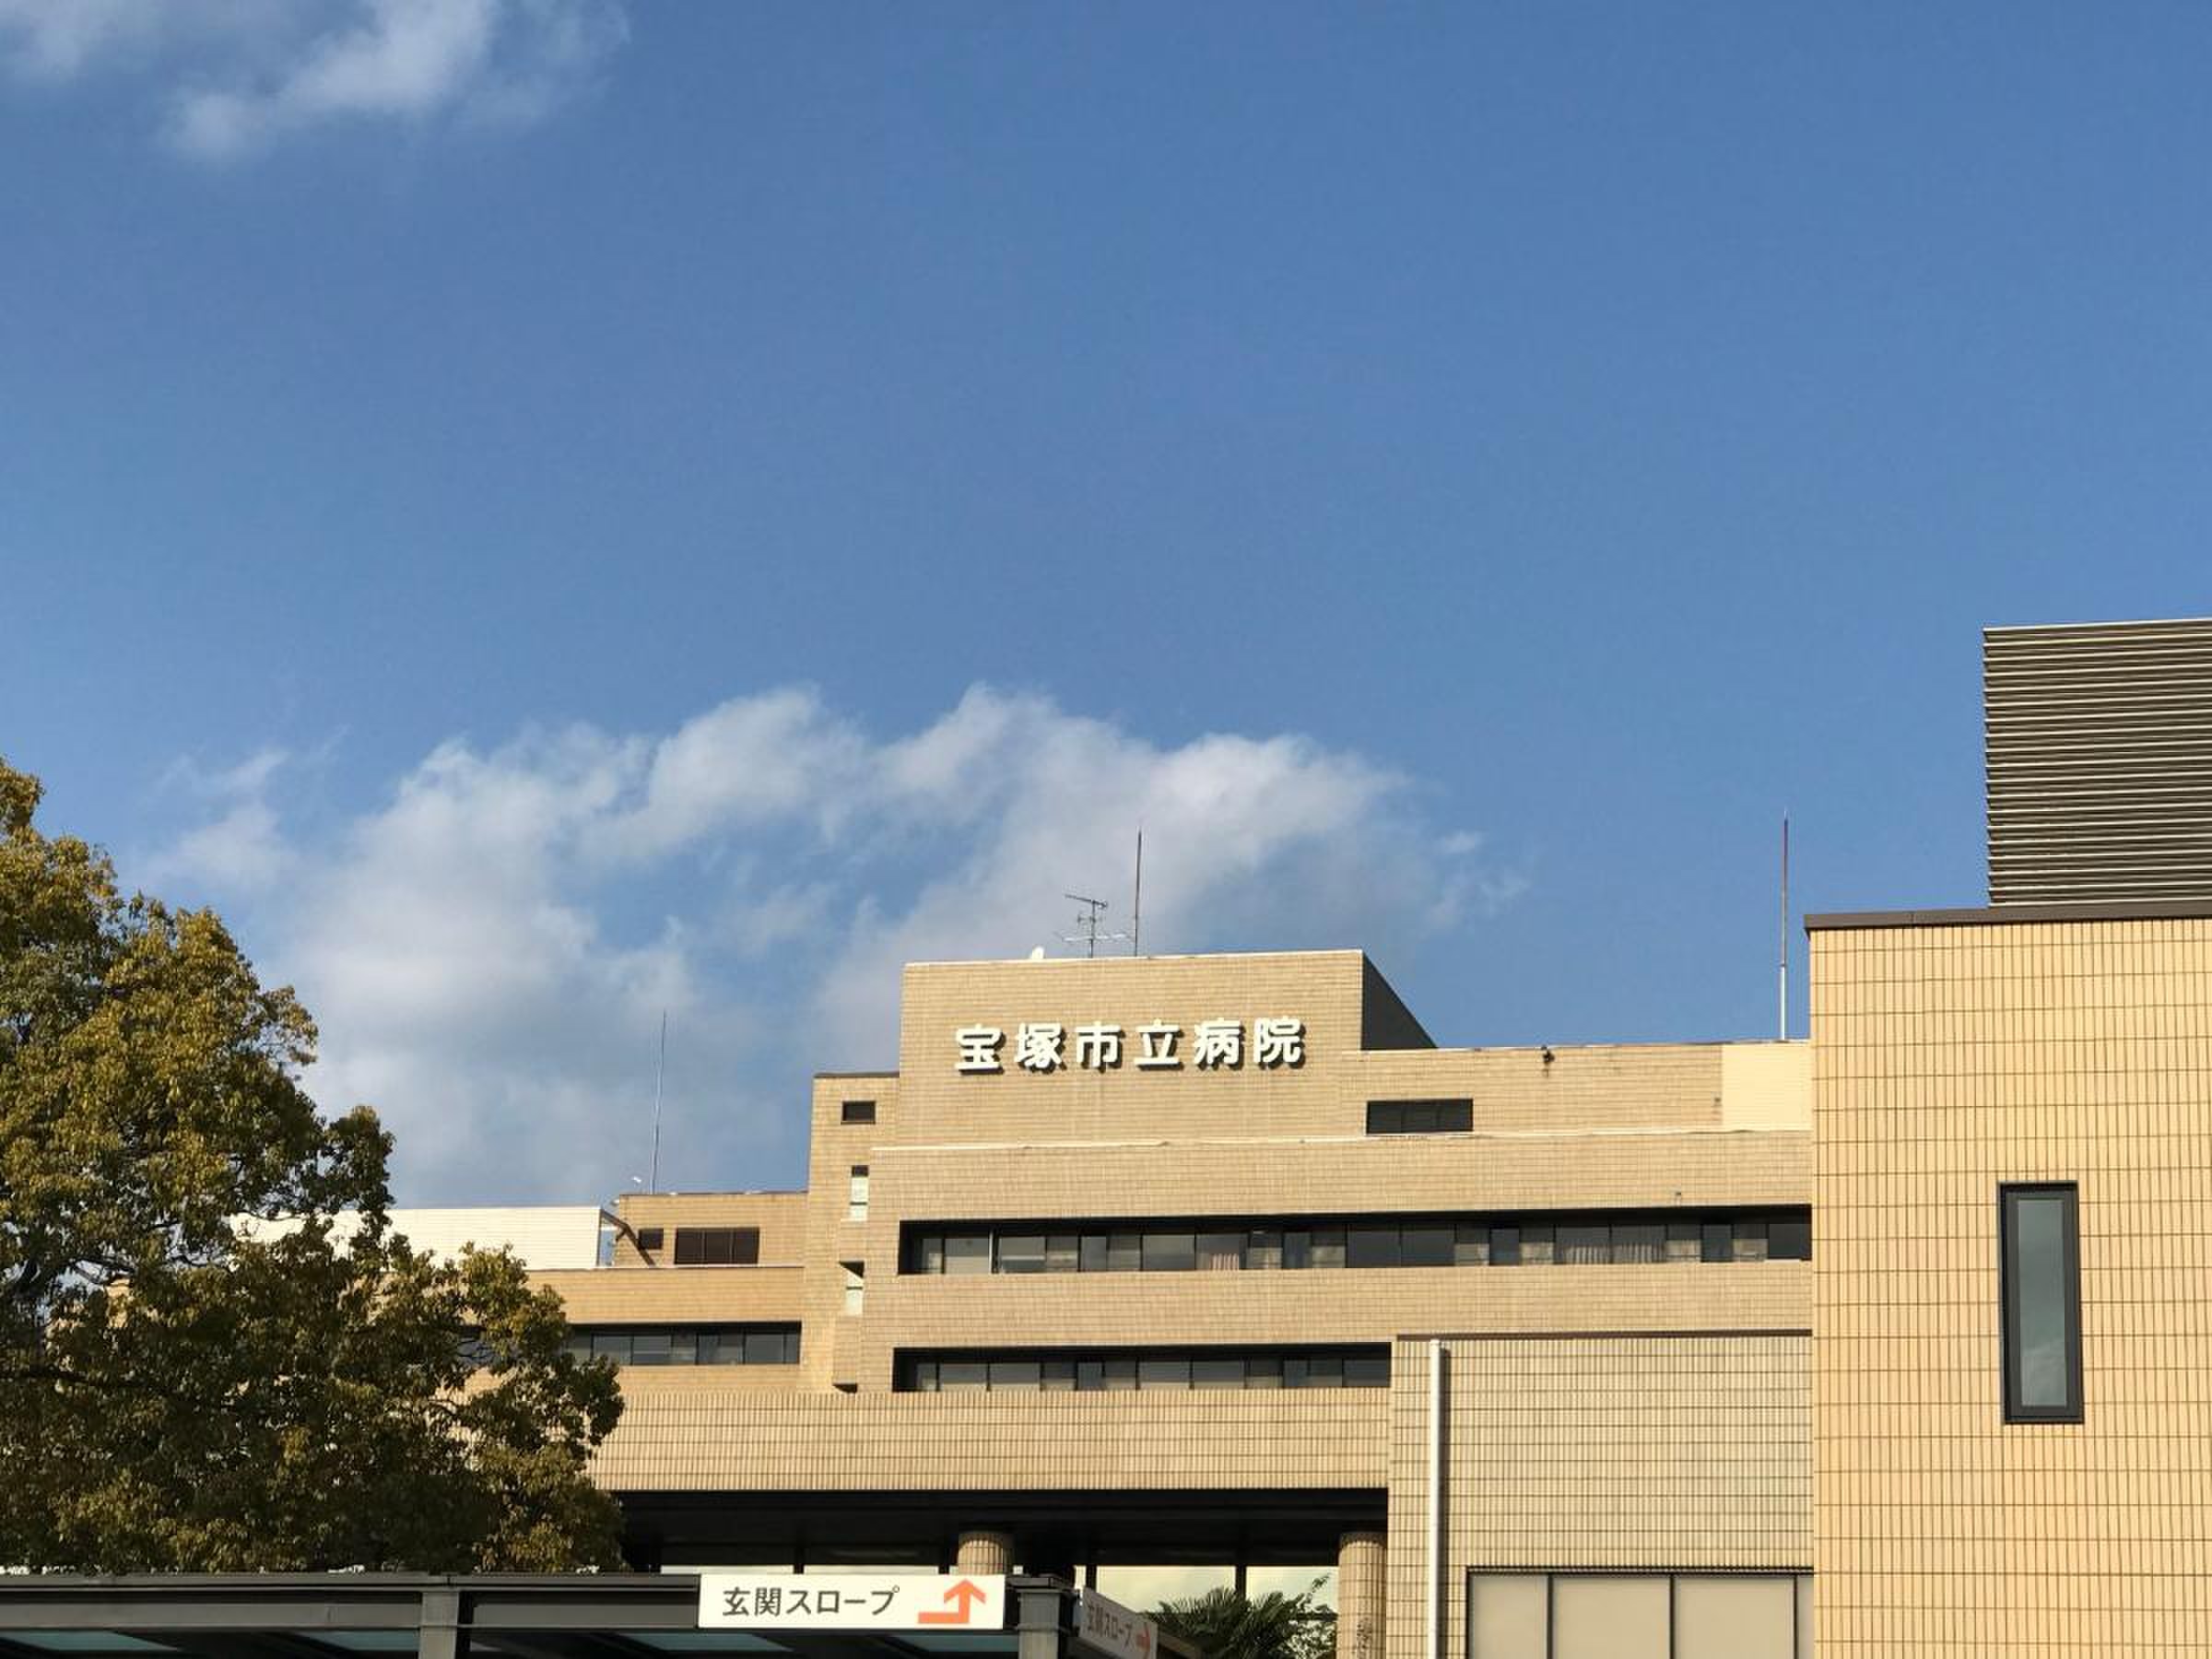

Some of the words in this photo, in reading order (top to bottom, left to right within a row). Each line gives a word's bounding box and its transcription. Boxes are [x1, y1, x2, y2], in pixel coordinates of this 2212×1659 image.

[954, 1016, 1303, 1071] 宝塚市立病院
[723, 1585, 900, 1618] 玄関スロープ
